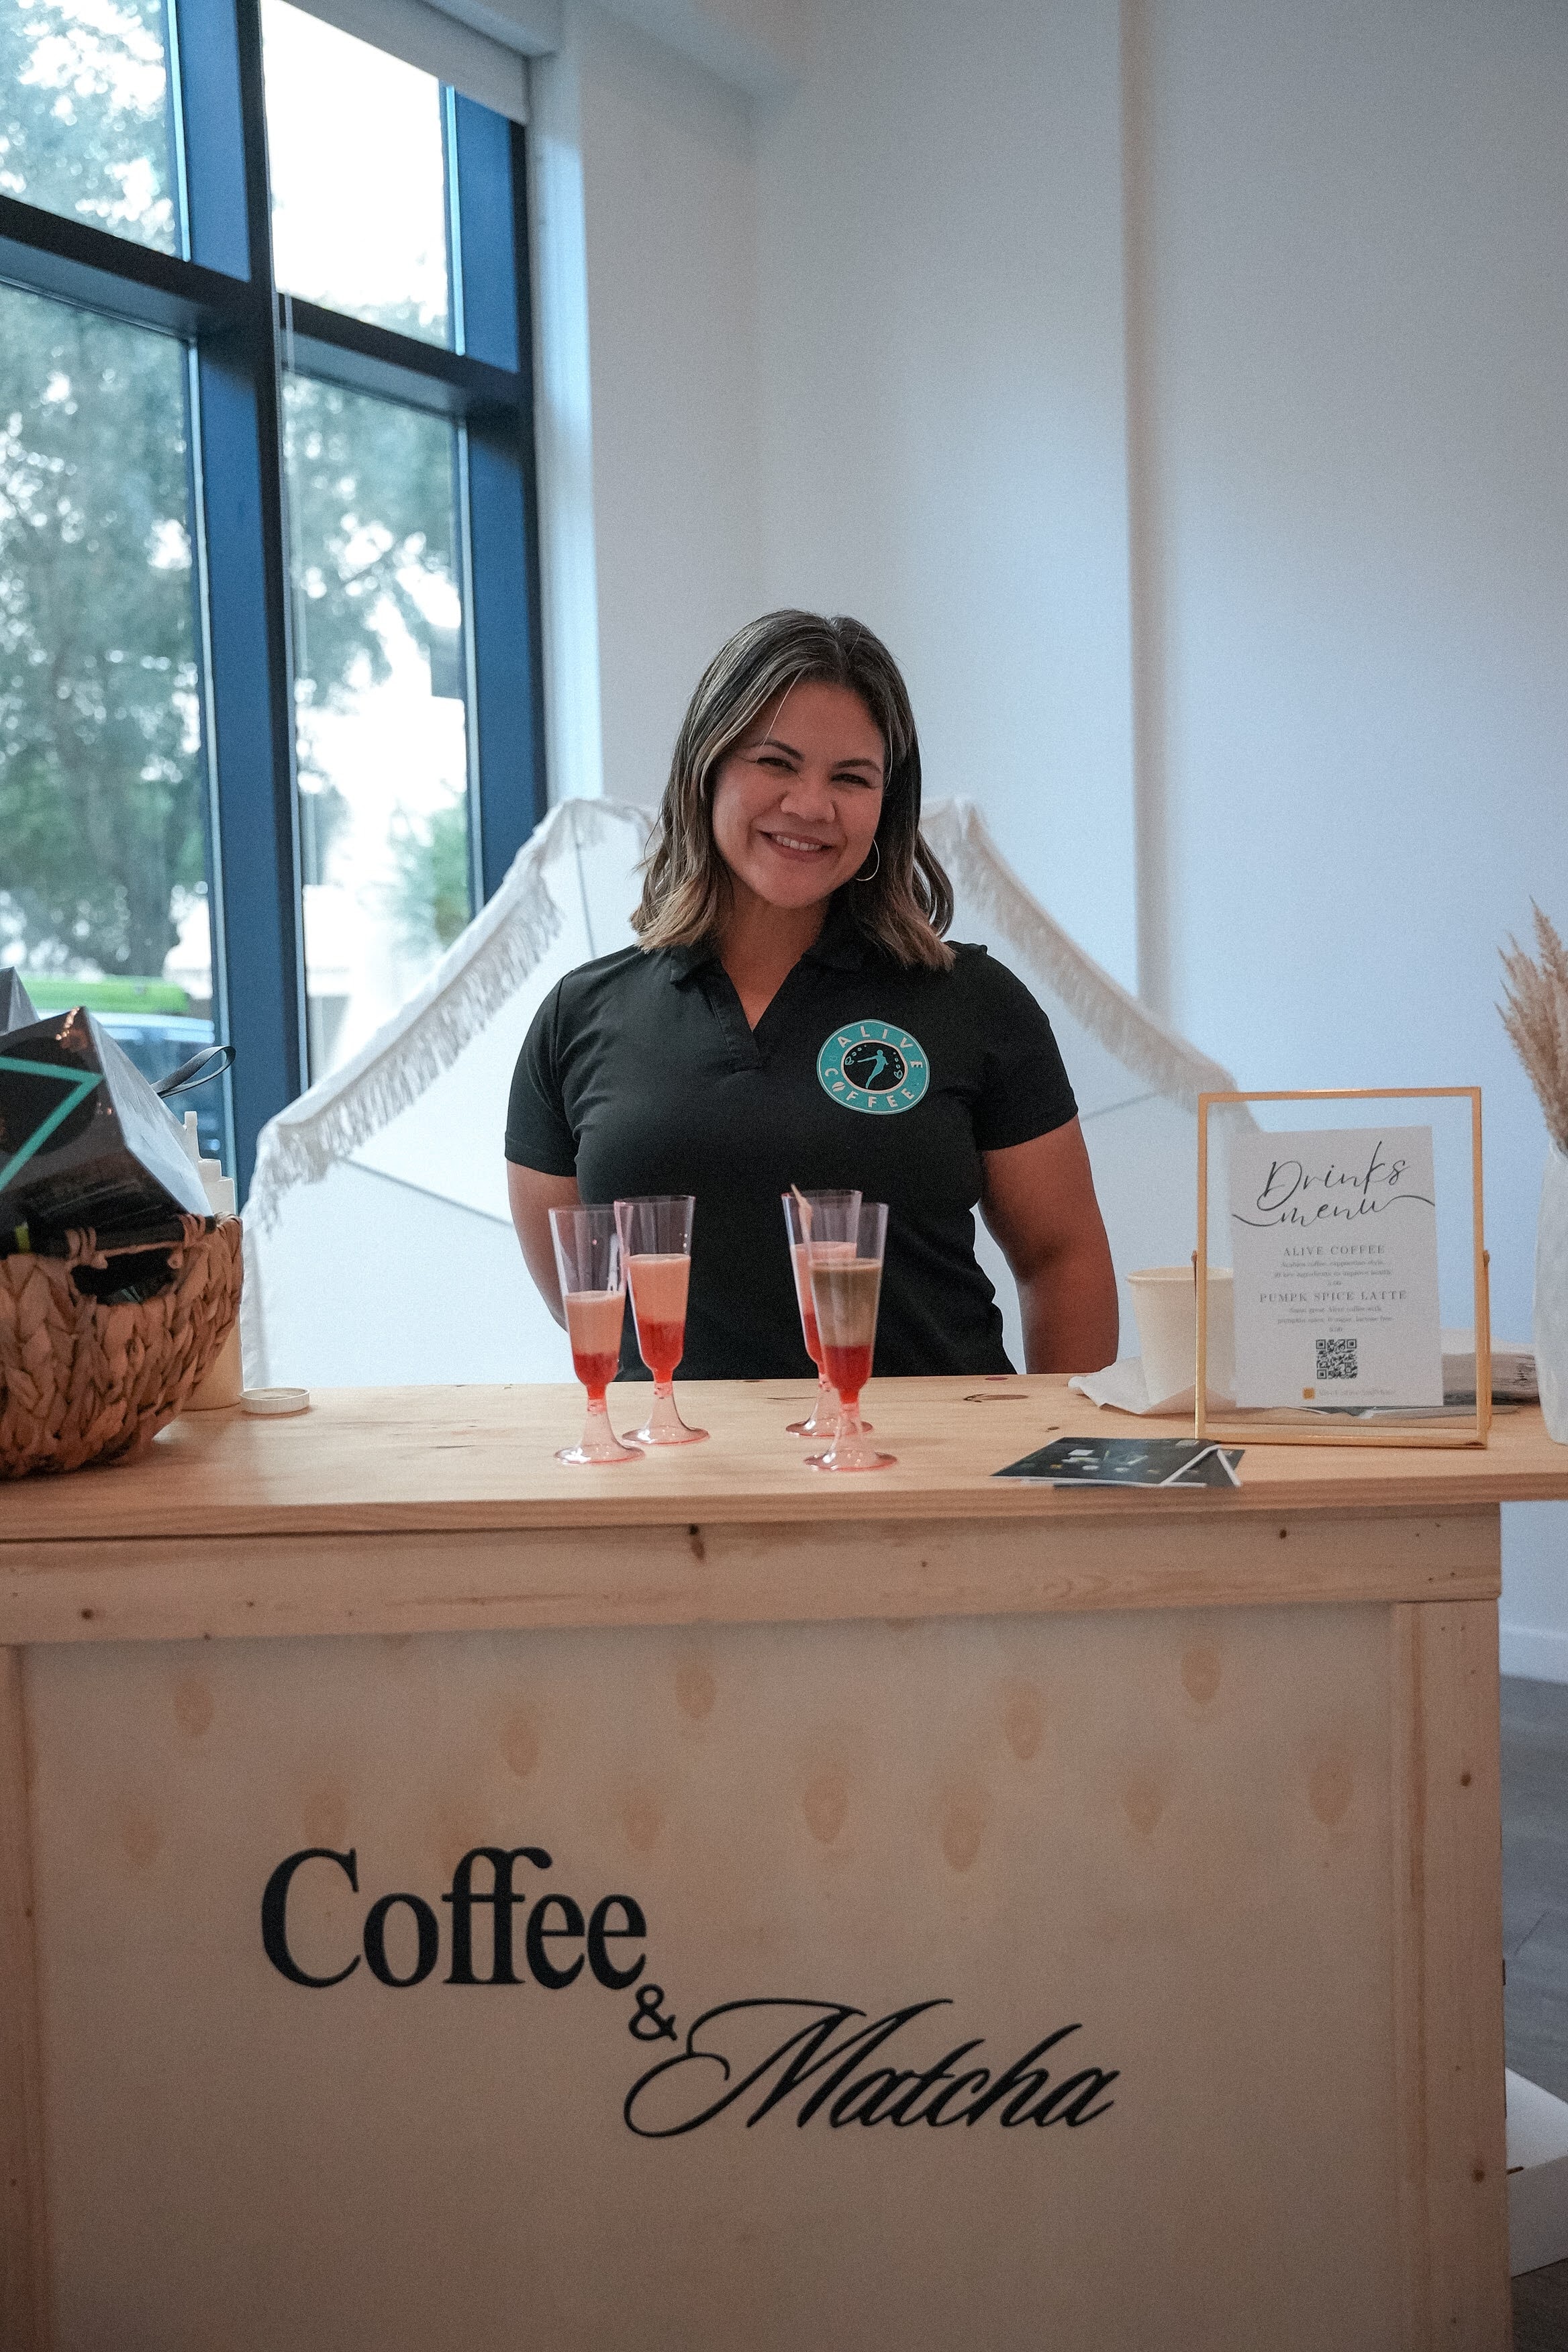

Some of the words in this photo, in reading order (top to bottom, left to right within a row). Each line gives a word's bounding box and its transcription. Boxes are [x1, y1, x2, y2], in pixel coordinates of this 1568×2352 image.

[837, 1026, 924, 1069] ALIVE
[824, 1067, 915, 1108] COFFEE
[1256, 1140, 1412, 1212] Drinks
[1231, 1195, 1436, 1228] menu
[1283, 1246, 1324, 1256] ALIVE
[1330, 1244, 1385, 1255] COFFEE
[1259, 1292, 1308, 1303] PUMPK
[1314, 1291, 1354, 1301] SPICE
[1361, 1289, 1408, 1300] LATTE
[260, 1847, 648, 1991] Coffee
[628, 1983, 679, 2043] &
[623, 1998, 1121, 2140] Matcha
